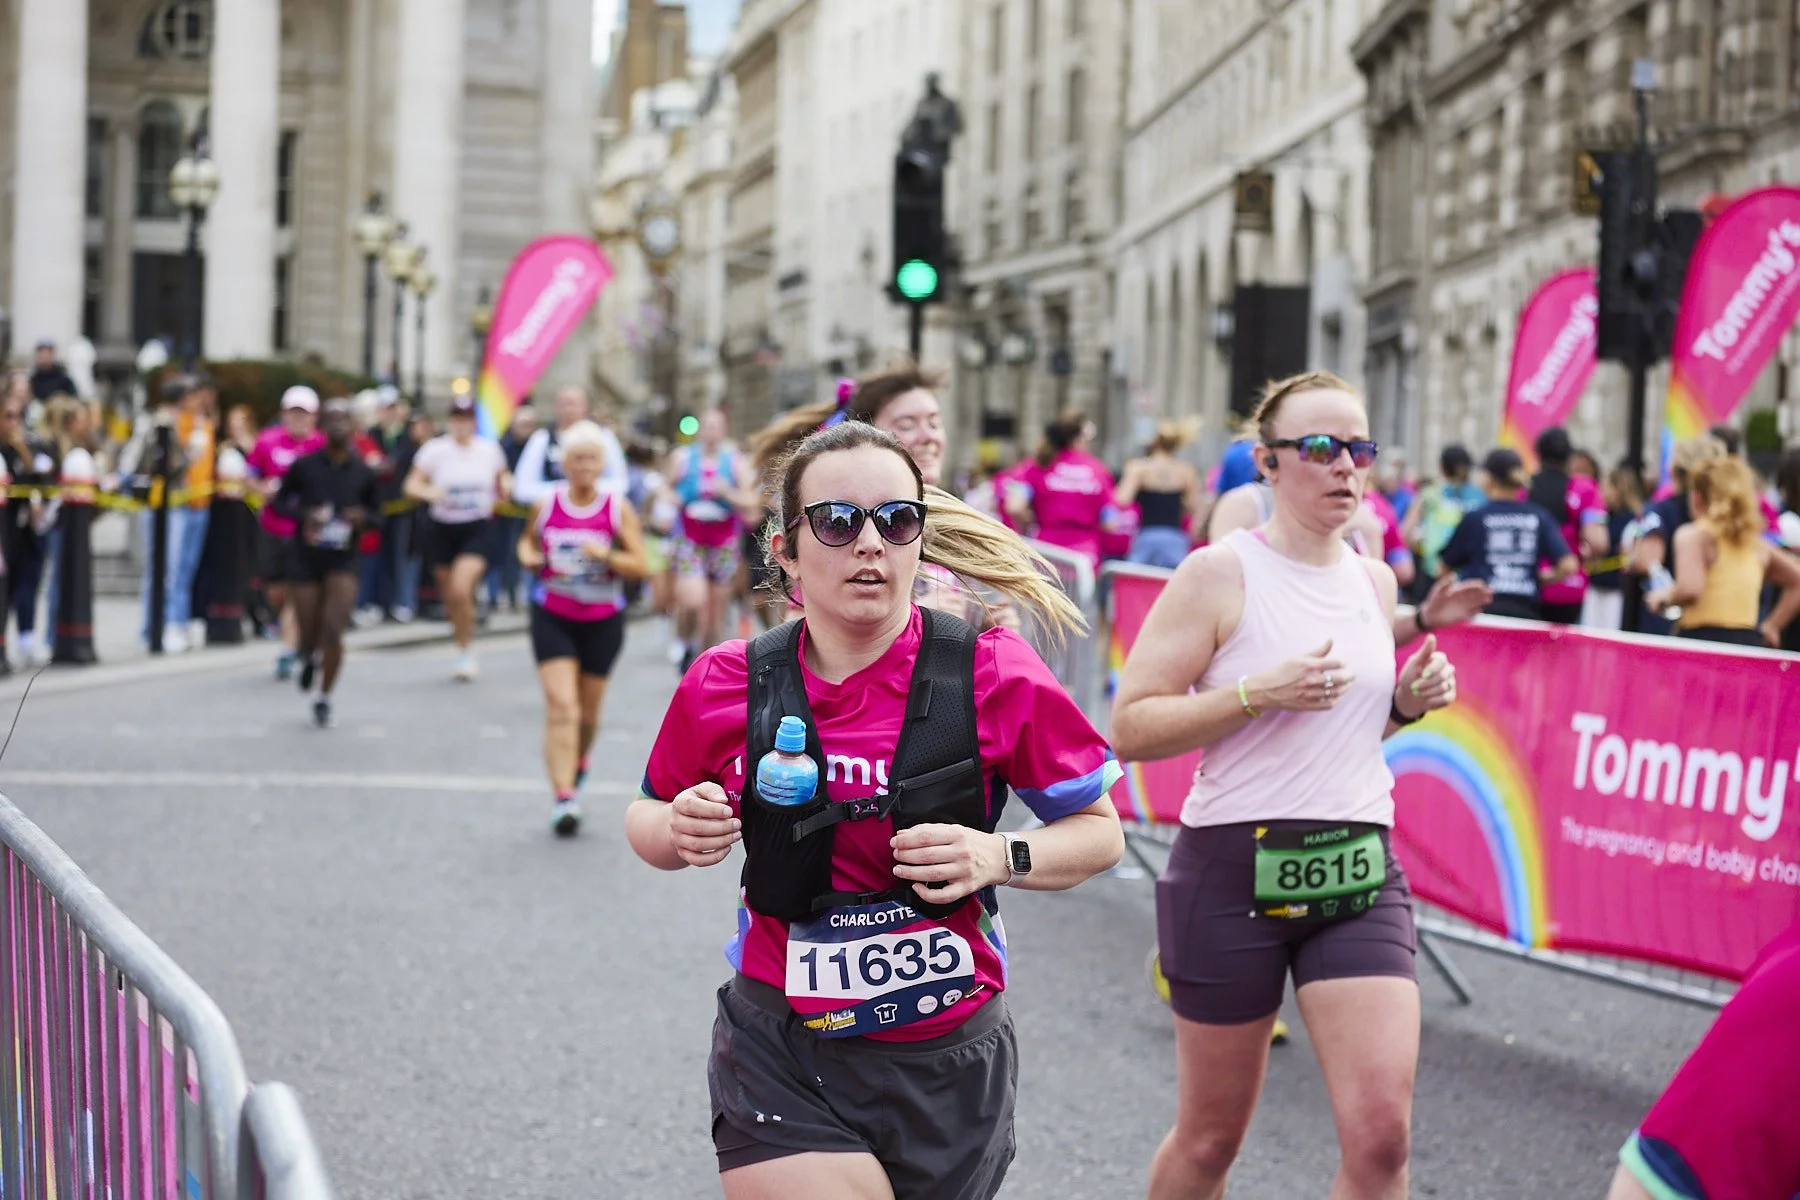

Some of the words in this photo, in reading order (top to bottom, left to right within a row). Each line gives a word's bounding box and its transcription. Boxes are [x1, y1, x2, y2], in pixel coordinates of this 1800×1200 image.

[1304, 828, 1349, 845] MARION
[1278, 847, 1370, 891] 8615
[1666, 841, 1704, 868] and
[1705, 842, 1756, 883] baby
[1759, 853, 1800, 886] cha
[830, 906, 916, 927] CHARLOTTE
[800, 931, 960, 991] 11635
